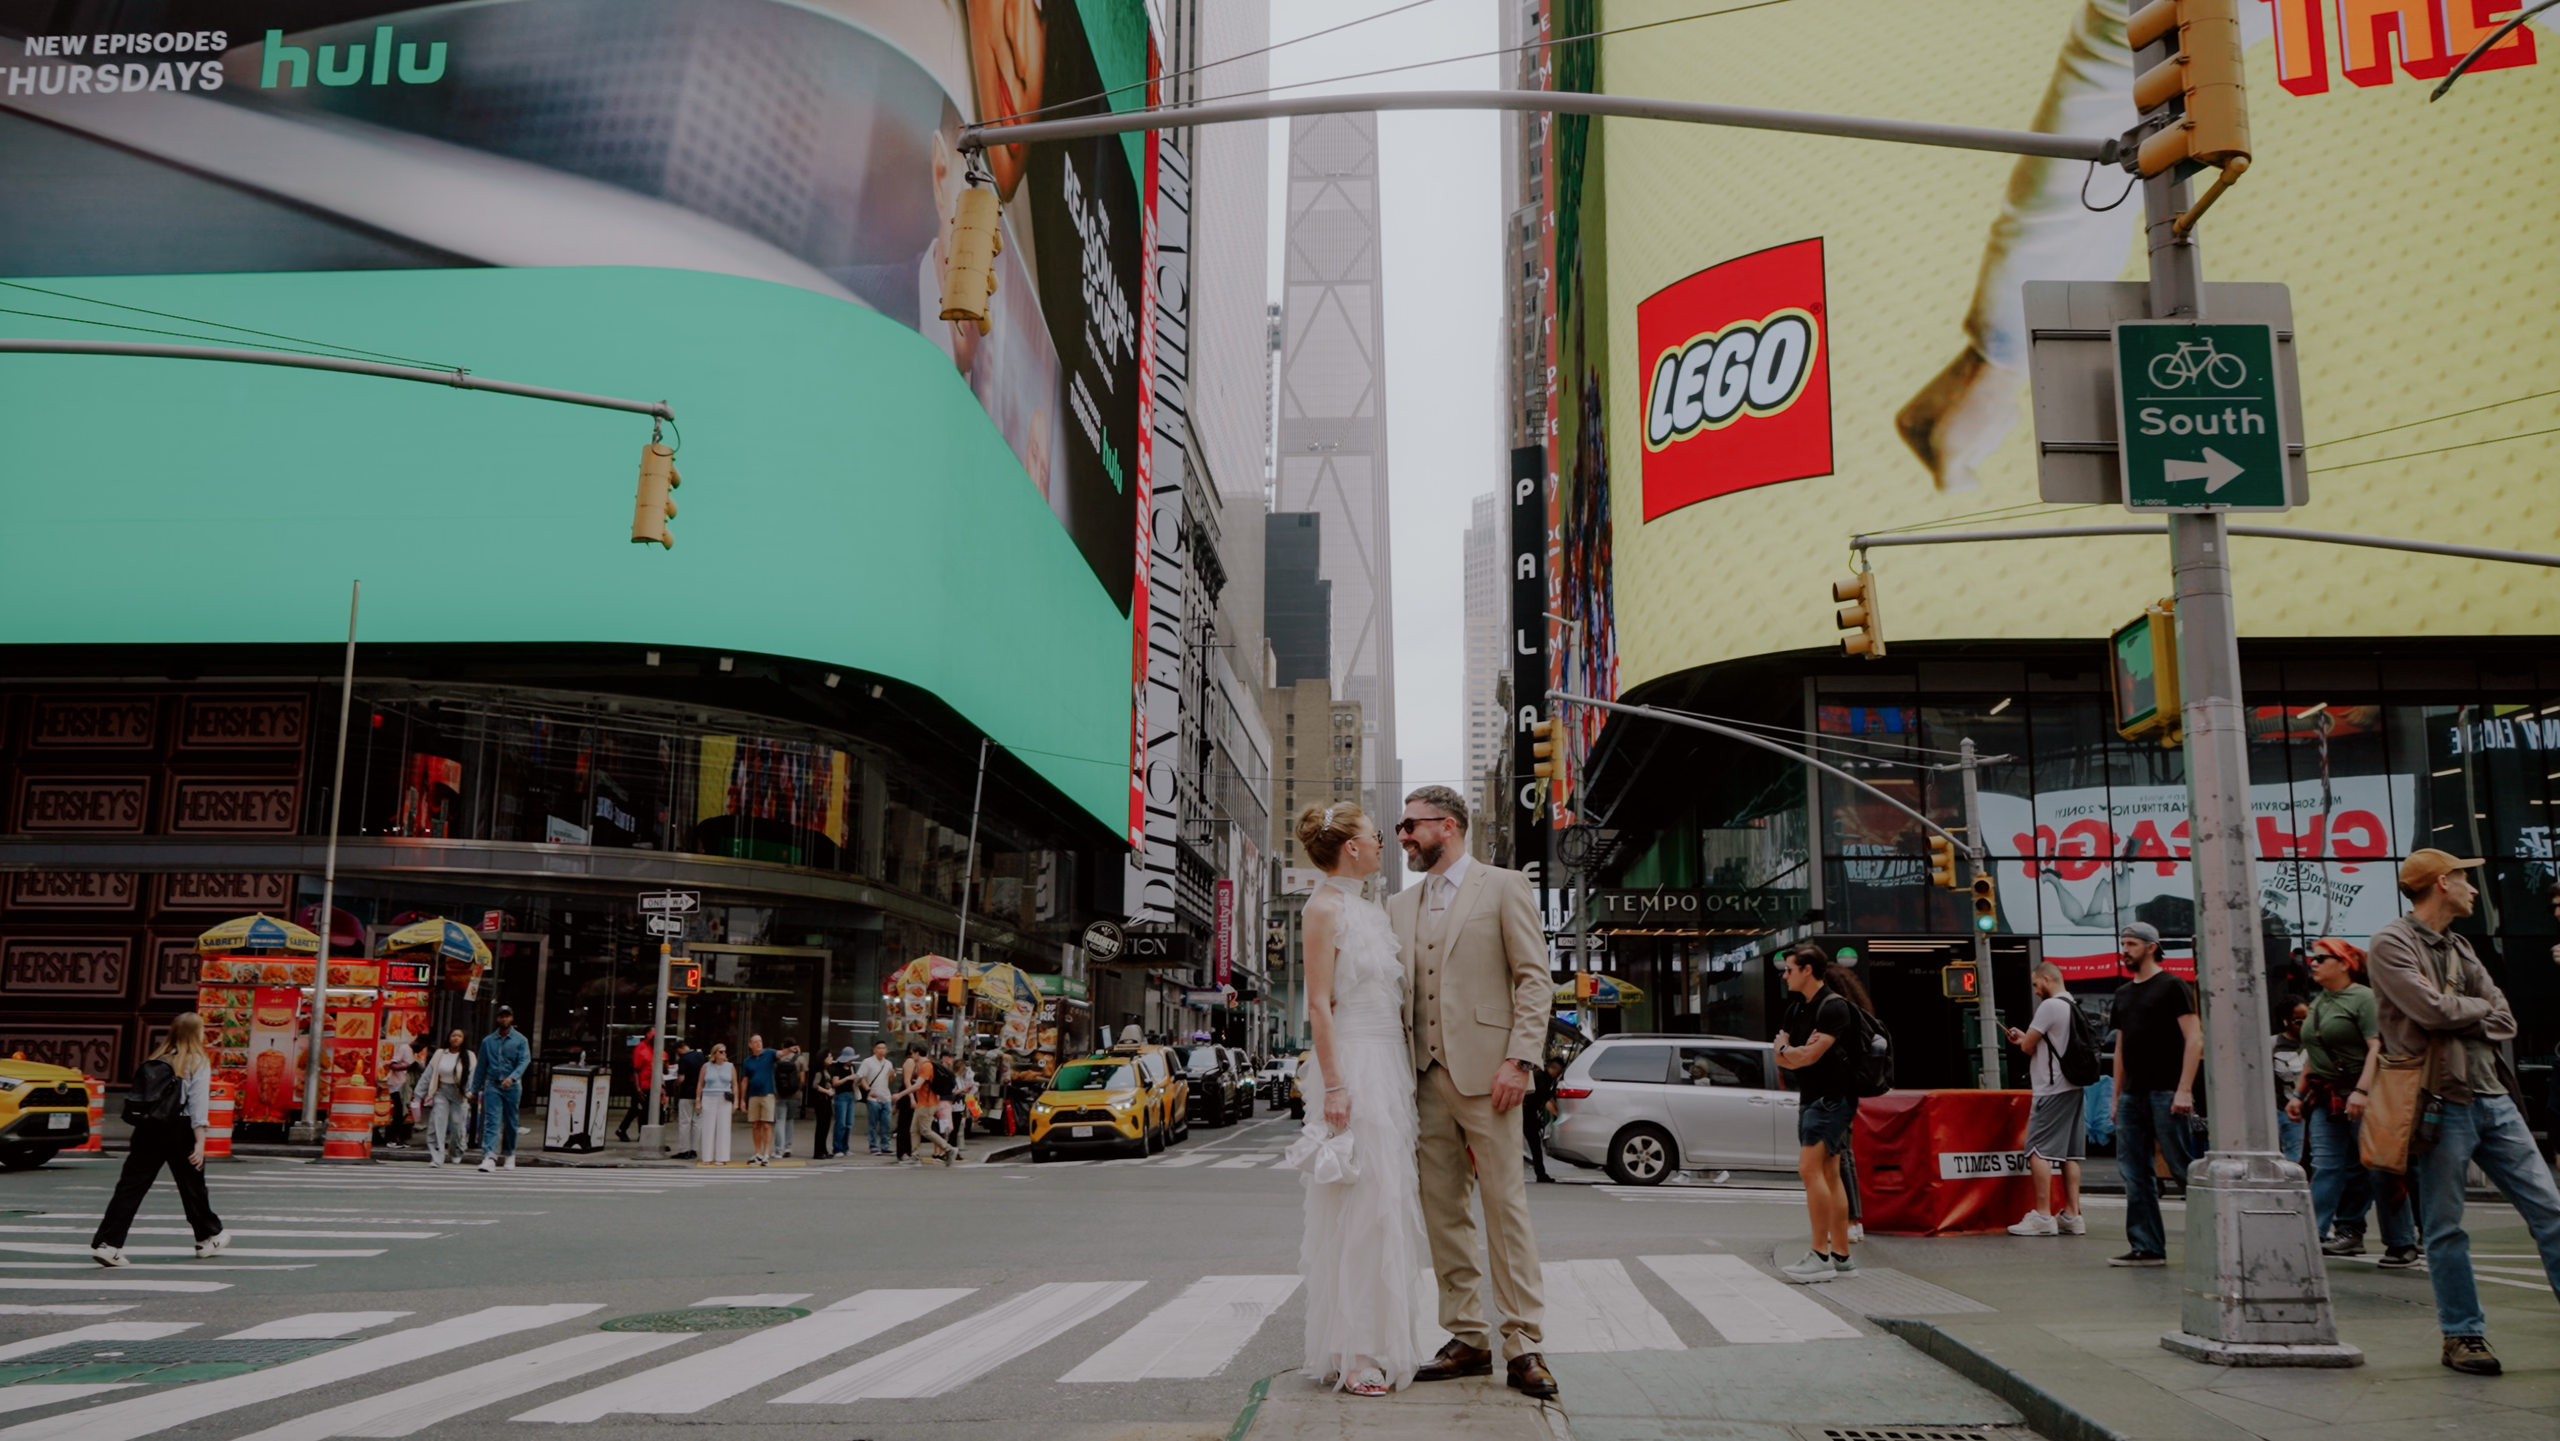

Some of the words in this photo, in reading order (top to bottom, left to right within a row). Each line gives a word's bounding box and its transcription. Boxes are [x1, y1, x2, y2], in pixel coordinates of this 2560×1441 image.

[25, 35, 88, 56] NEW
[92, 30, 229, 55] EPISODES
[260, 26, 448, 89] hulu
[0, 60, 224, 96] HURSDAYS
[1063, 151, 1136, 360] REASONABLE
[1082, 248, 1120, 367] DOUBT
[1139, 204, 1158, 440] HERSHEY'S
[1153, 225, 1190, 448] EDITION
[1647, 311, 1815, 447] LEGO
[2138, 406, 2266, 436] South
[1102, 425, 1123, 495] hulu
[1135, 441, 1152, 587] STORE
[1148, 469, 1183, 694] EDITION
[38, 704, 149, 738] HERSHEY'S
[189, 704, 300, 738] HERSHEY'S
[27, 788, 140, 822] HERSHEY'S
[180, 788, 293, 822] HERSHEY'S
[647, 898, 665, 907] ONE
[672, 897, 690, 906] WAY
[1603, 888, 1699, 920] TEMPO
[203, 937, 244, 947] SABRETT
[289, 937, 320, 948] SABRETT
[1085, 928, 1120, 953] HERSHEY'S
[1562, 937, 1577, 945] ONE
[7, 949, 121, 985] HERSHEY'S
[686, 968, 699, 988] 12
[1961, 972, 1975, 992] 12
[1044, 1003, 1057, 1012] OF
[1953, 1154, 2002, 1174] TIMES
